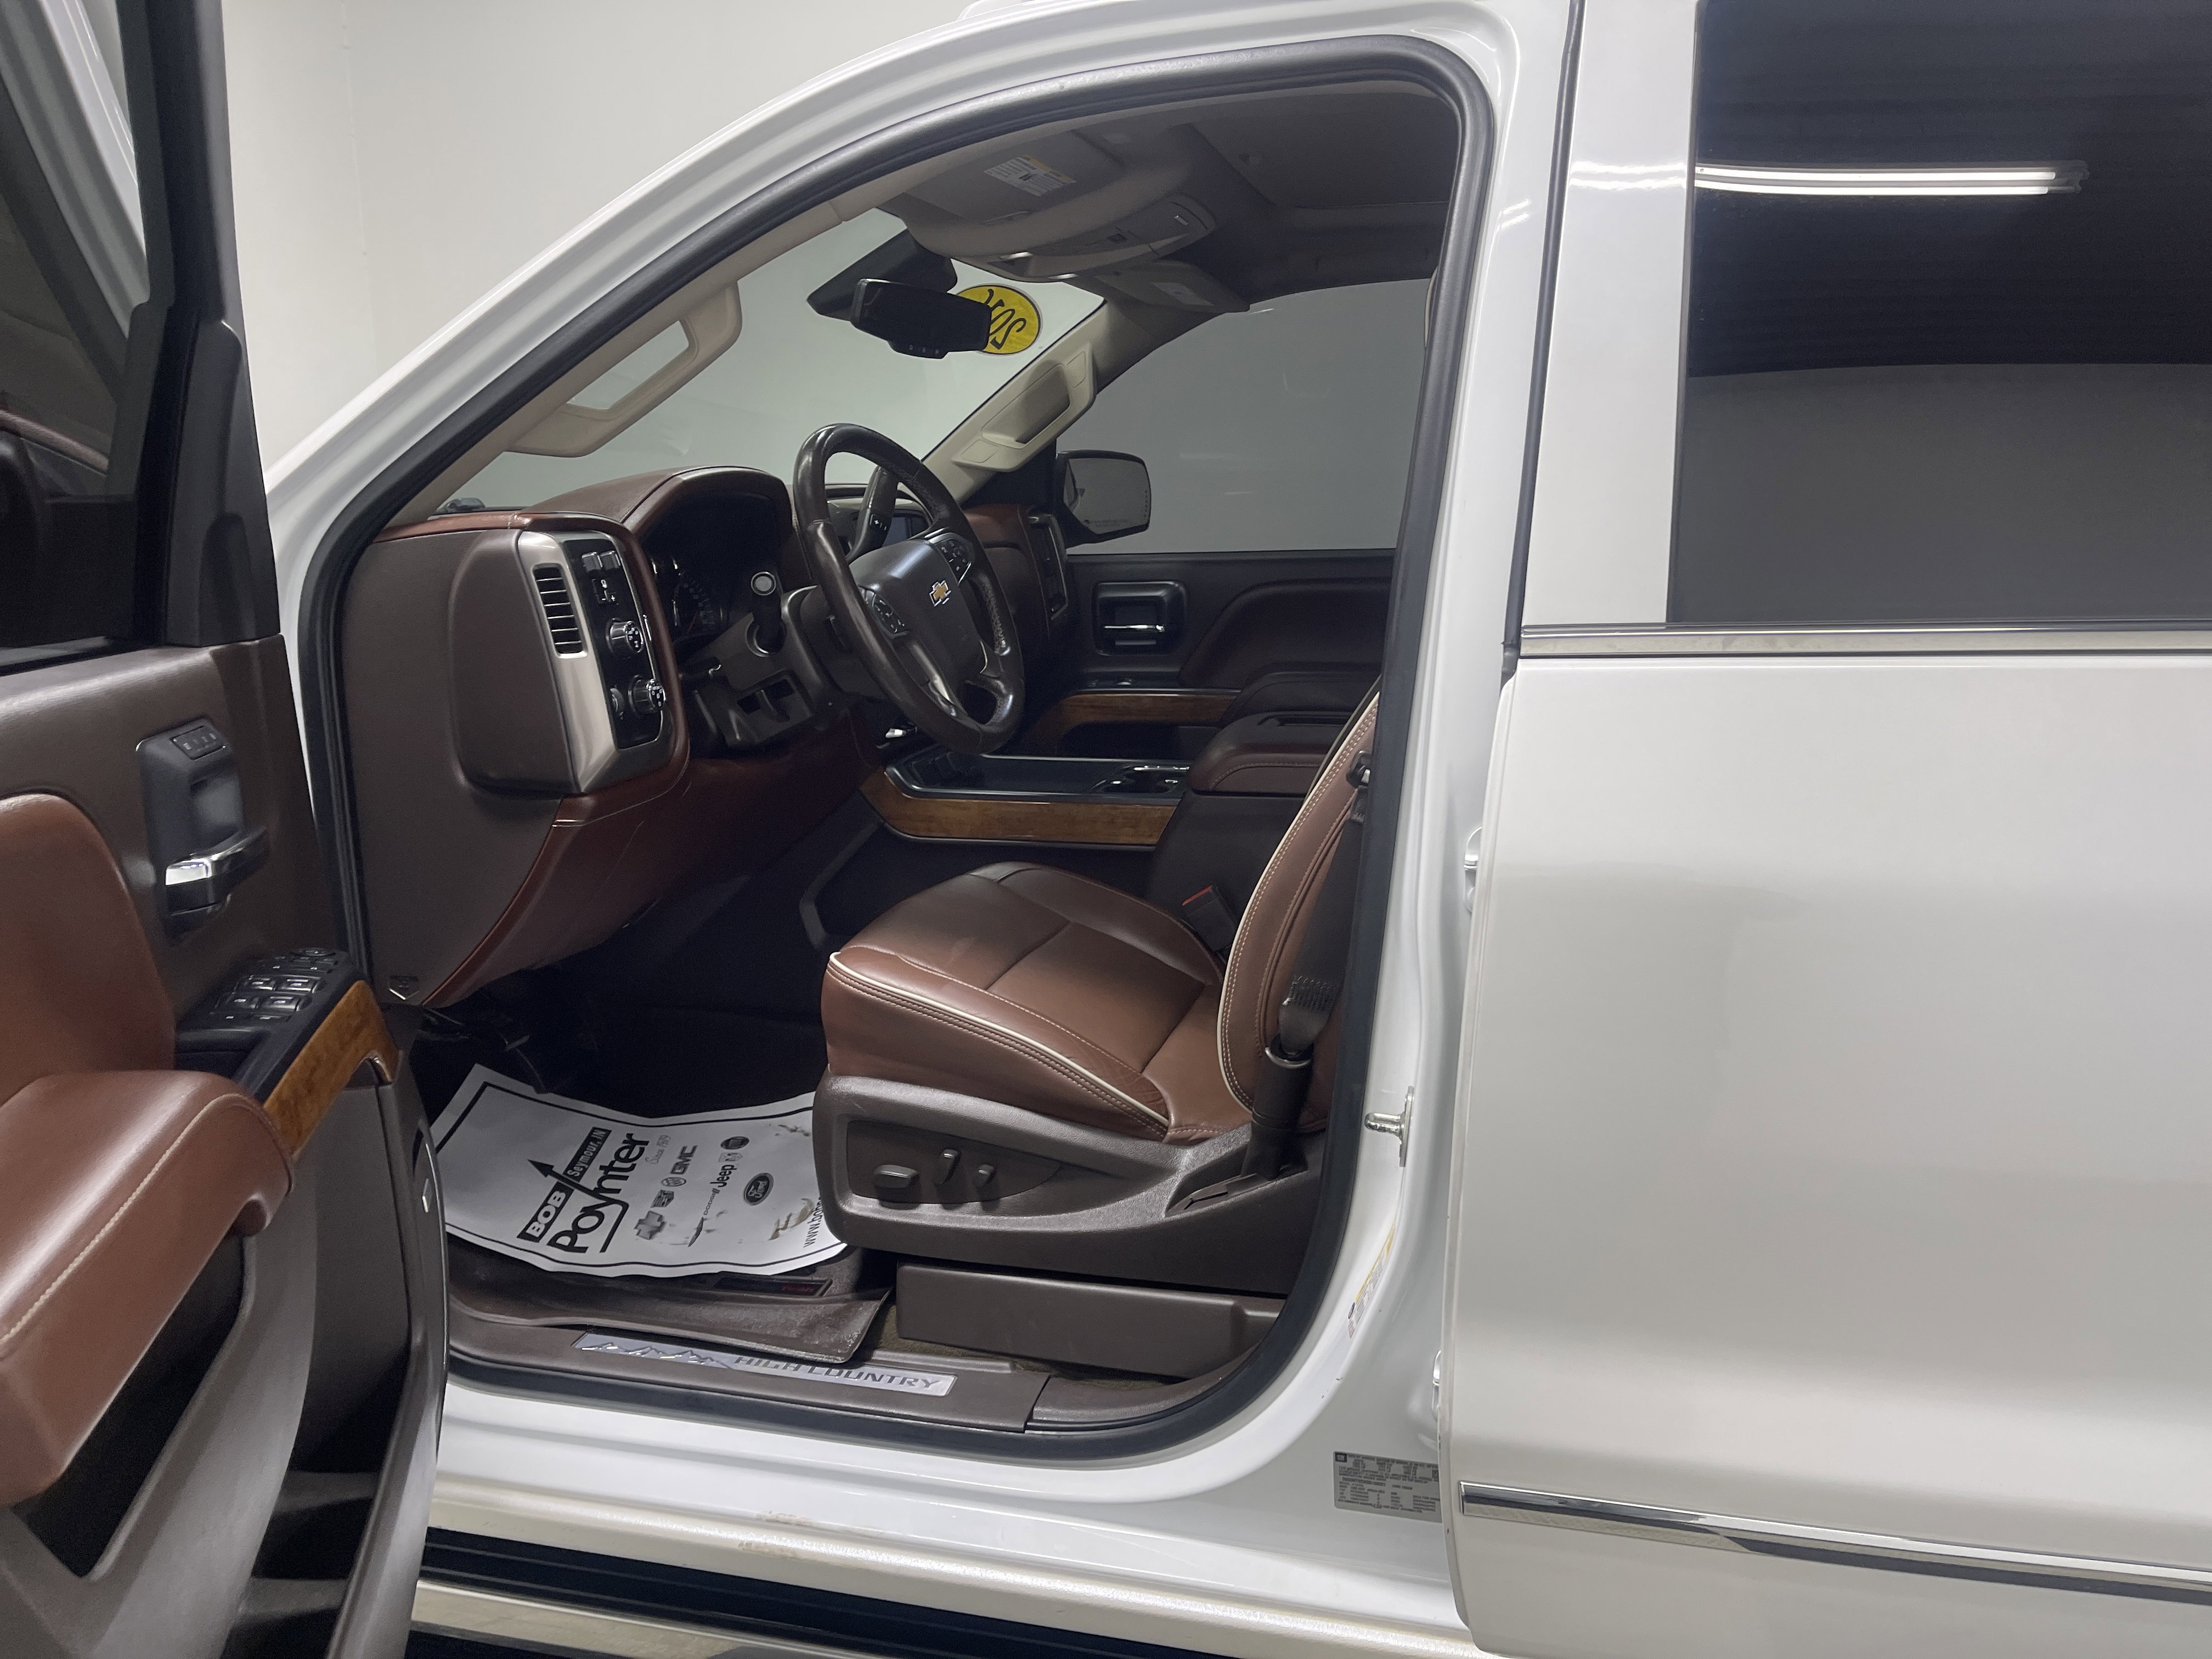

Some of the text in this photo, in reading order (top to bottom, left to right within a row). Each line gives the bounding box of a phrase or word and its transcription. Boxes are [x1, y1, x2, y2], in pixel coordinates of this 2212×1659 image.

[567, 1129, 607, 1177] Seymour, IN
[670, 1145, 698, 1175] GMC
[546, 1133, 650, 1253] Poynter
[709, 1164, 737, 1188] Jeep
[526, 1190, 566, 1238] BOB
[734, 1357, 941, 1389] HIGH COUNTRY
